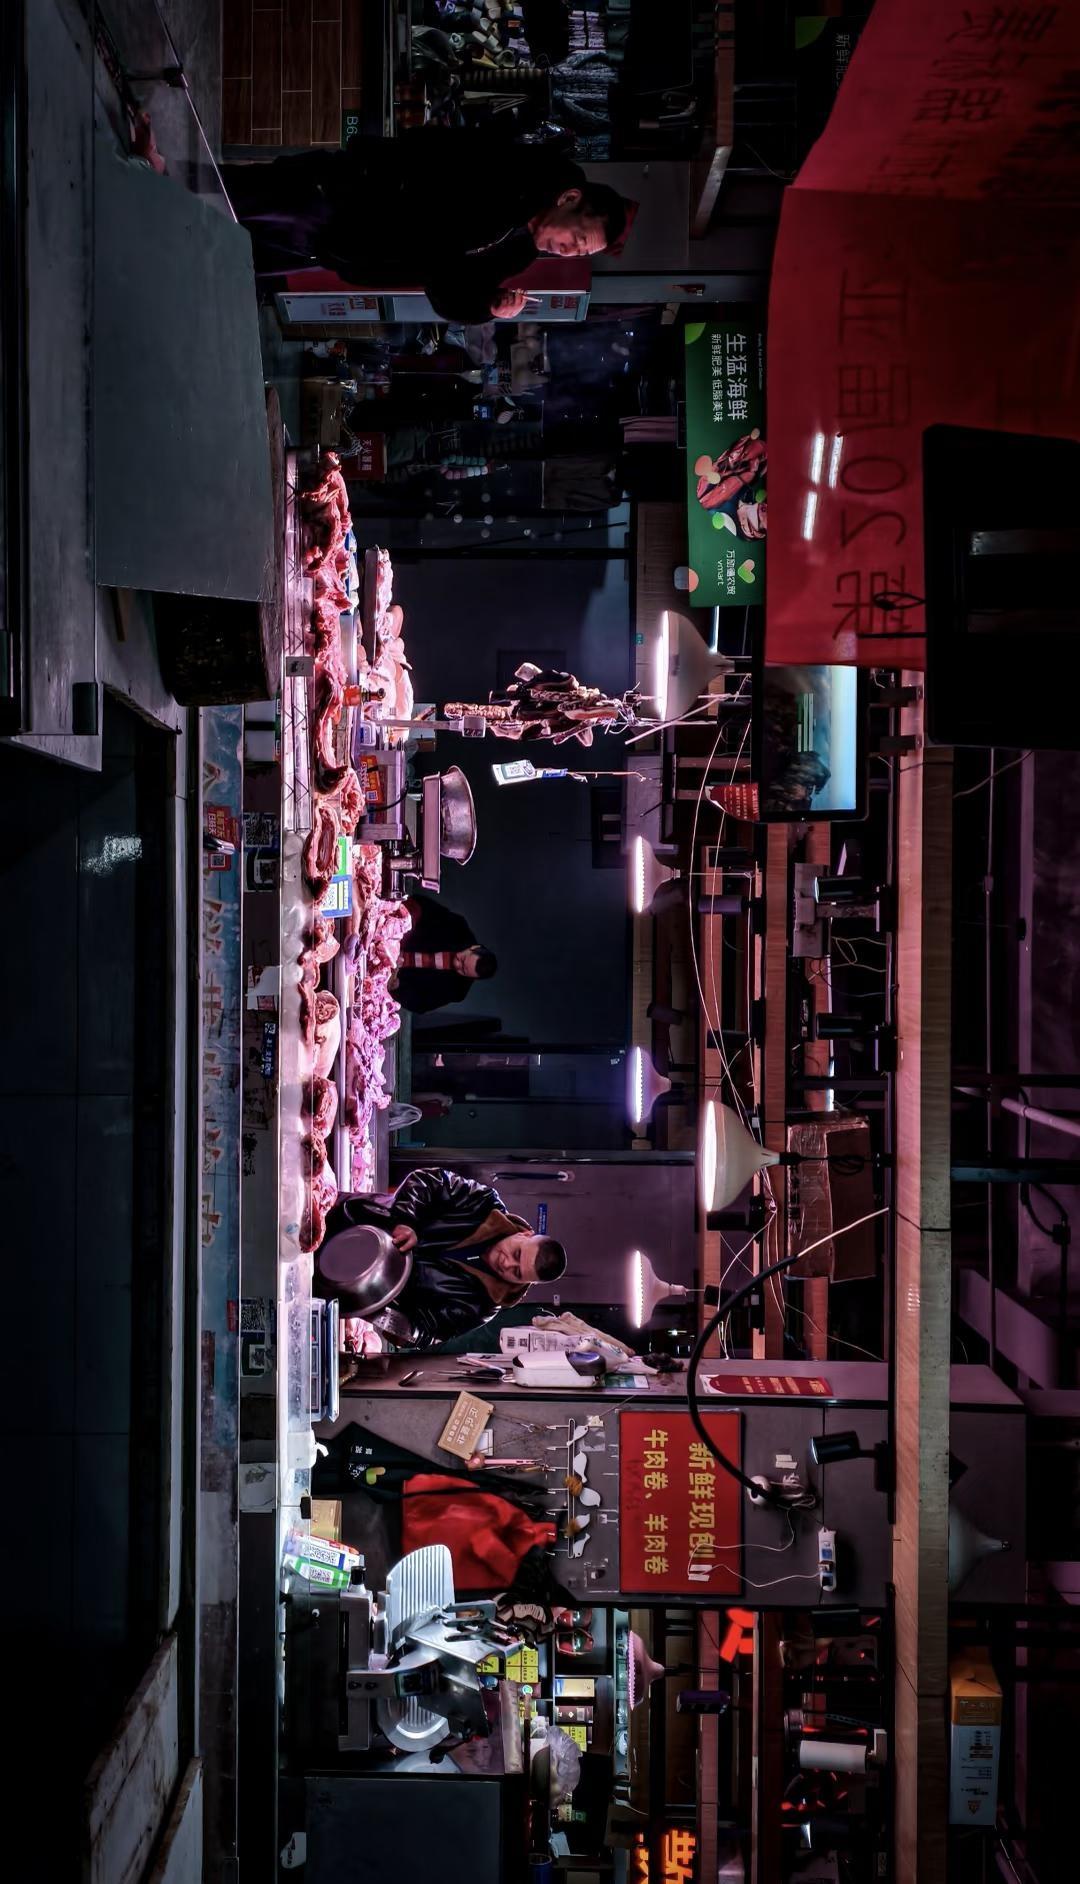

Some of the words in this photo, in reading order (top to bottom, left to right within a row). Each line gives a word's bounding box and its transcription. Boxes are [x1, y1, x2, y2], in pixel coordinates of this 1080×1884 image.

[835, 32, 850, 86] 新鲜肥
[346, 116, 359, 143] B6
[711, 333, 722, 377] 新鲜肥美
[726, 333, 748, 422] 生猛海鲜
[712, 379, 723, 423] 低脂美味
[644, 1429, 669, 1575] 牛肉卷、羊肉卷
[688, 1442, 716, 1560] 新鲜现刨
